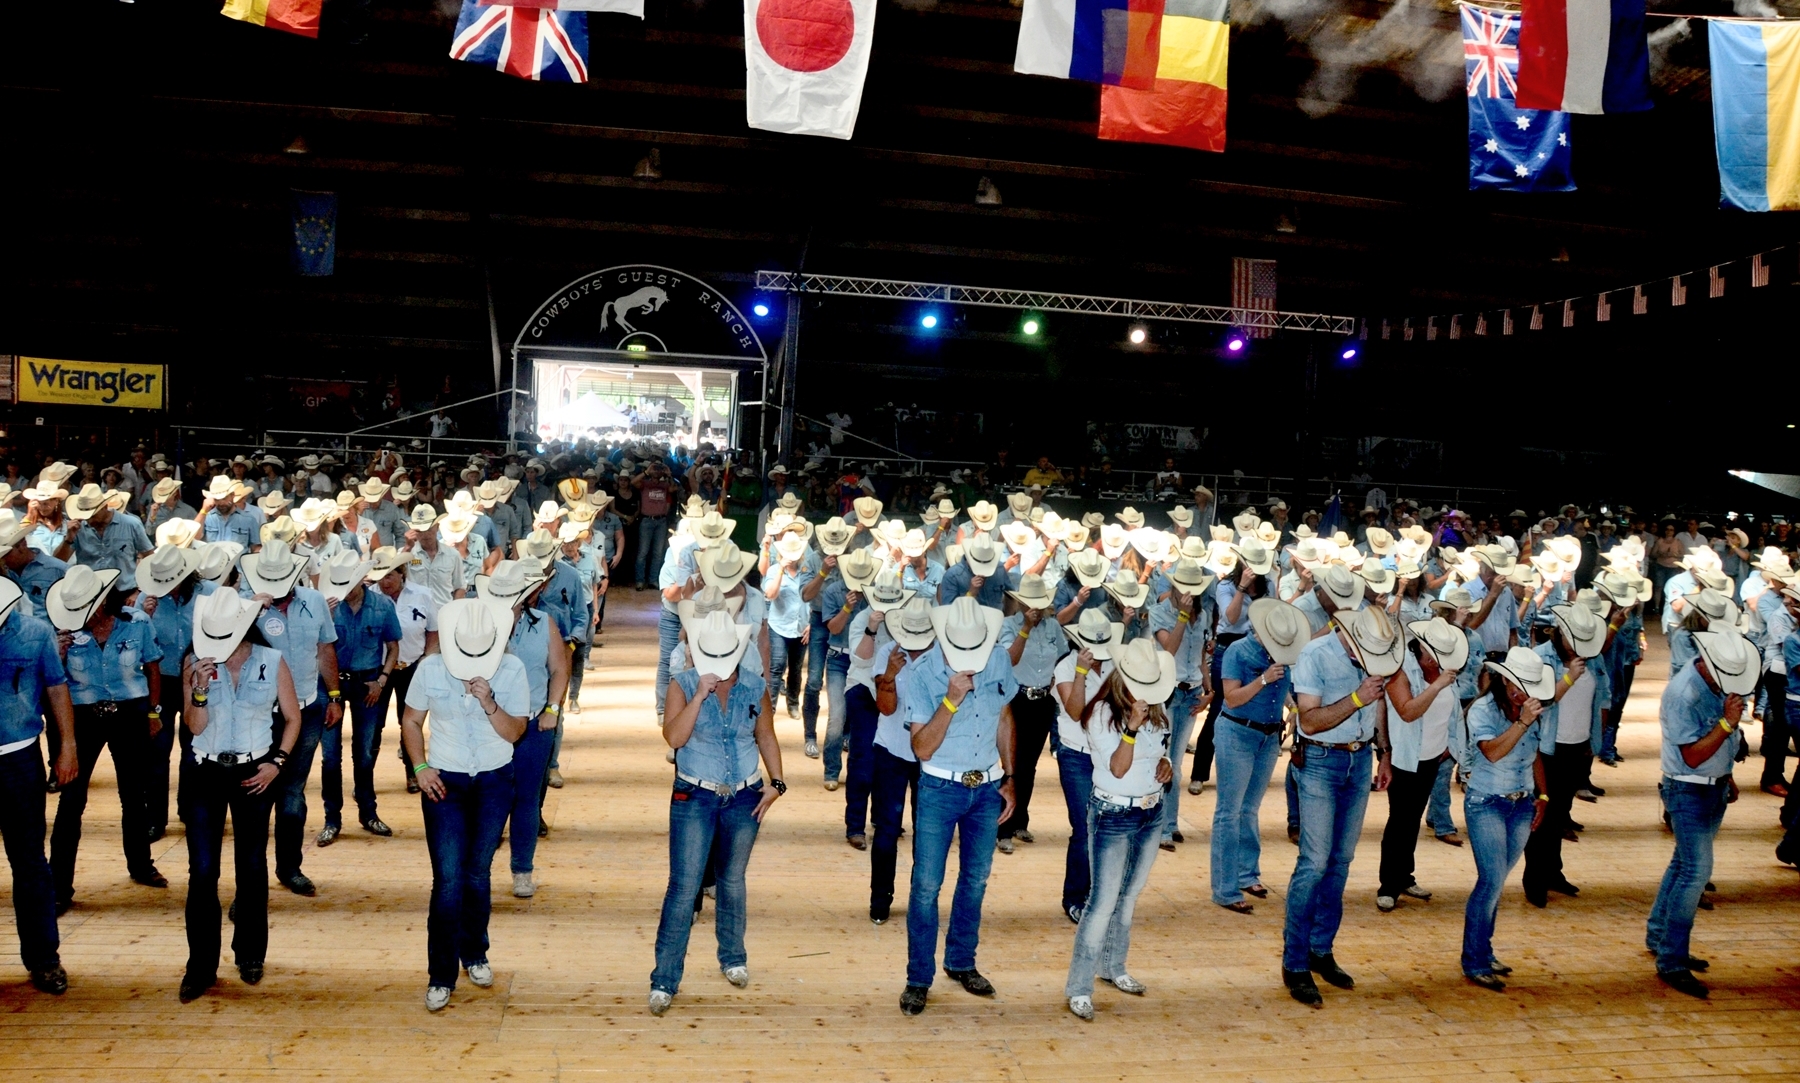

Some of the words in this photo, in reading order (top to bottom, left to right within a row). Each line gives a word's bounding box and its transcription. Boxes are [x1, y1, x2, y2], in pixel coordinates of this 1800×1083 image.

[617, 271, 681, 288] GUEST
[698, 291, 752, 348] RANCH
[28, 361, 156, 404] Wrangler
